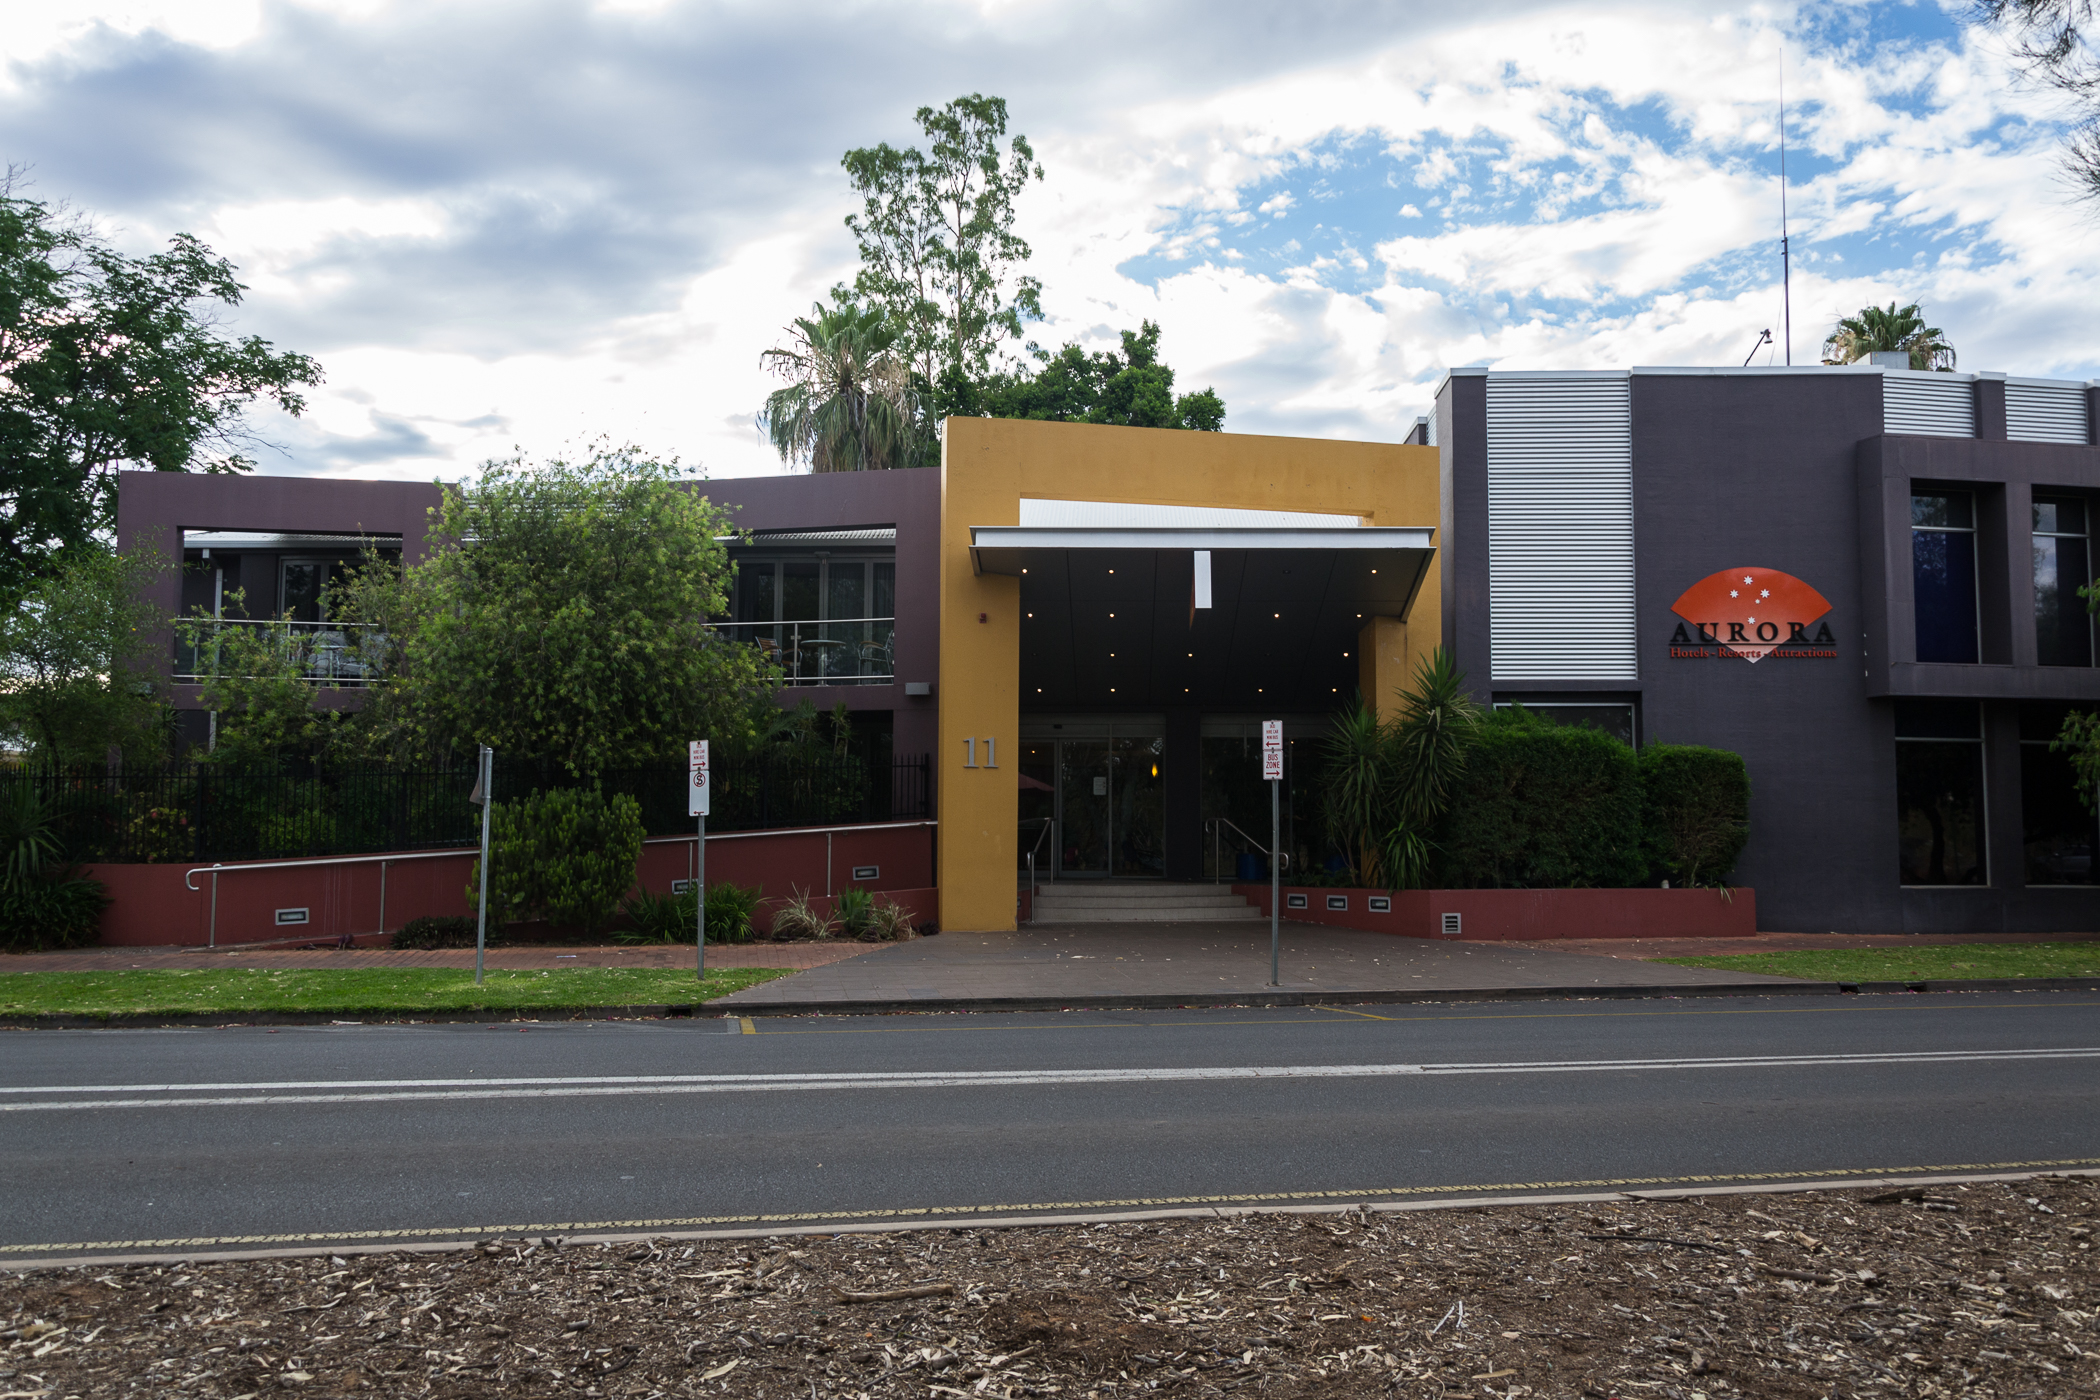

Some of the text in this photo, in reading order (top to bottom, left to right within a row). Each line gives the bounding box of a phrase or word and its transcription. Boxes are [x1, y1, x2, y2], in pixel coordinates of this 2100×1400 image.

[1669, 621, 1836, 642] AURORA
[1670, 647, 1709, 659] Hotels
[1718, 647, 1761, 659] Resorts
[1771, 647, 1837, 659] Attractions
[963, 736, 999, 768] 11
[1266, 761, 1280, 769] ZONE
